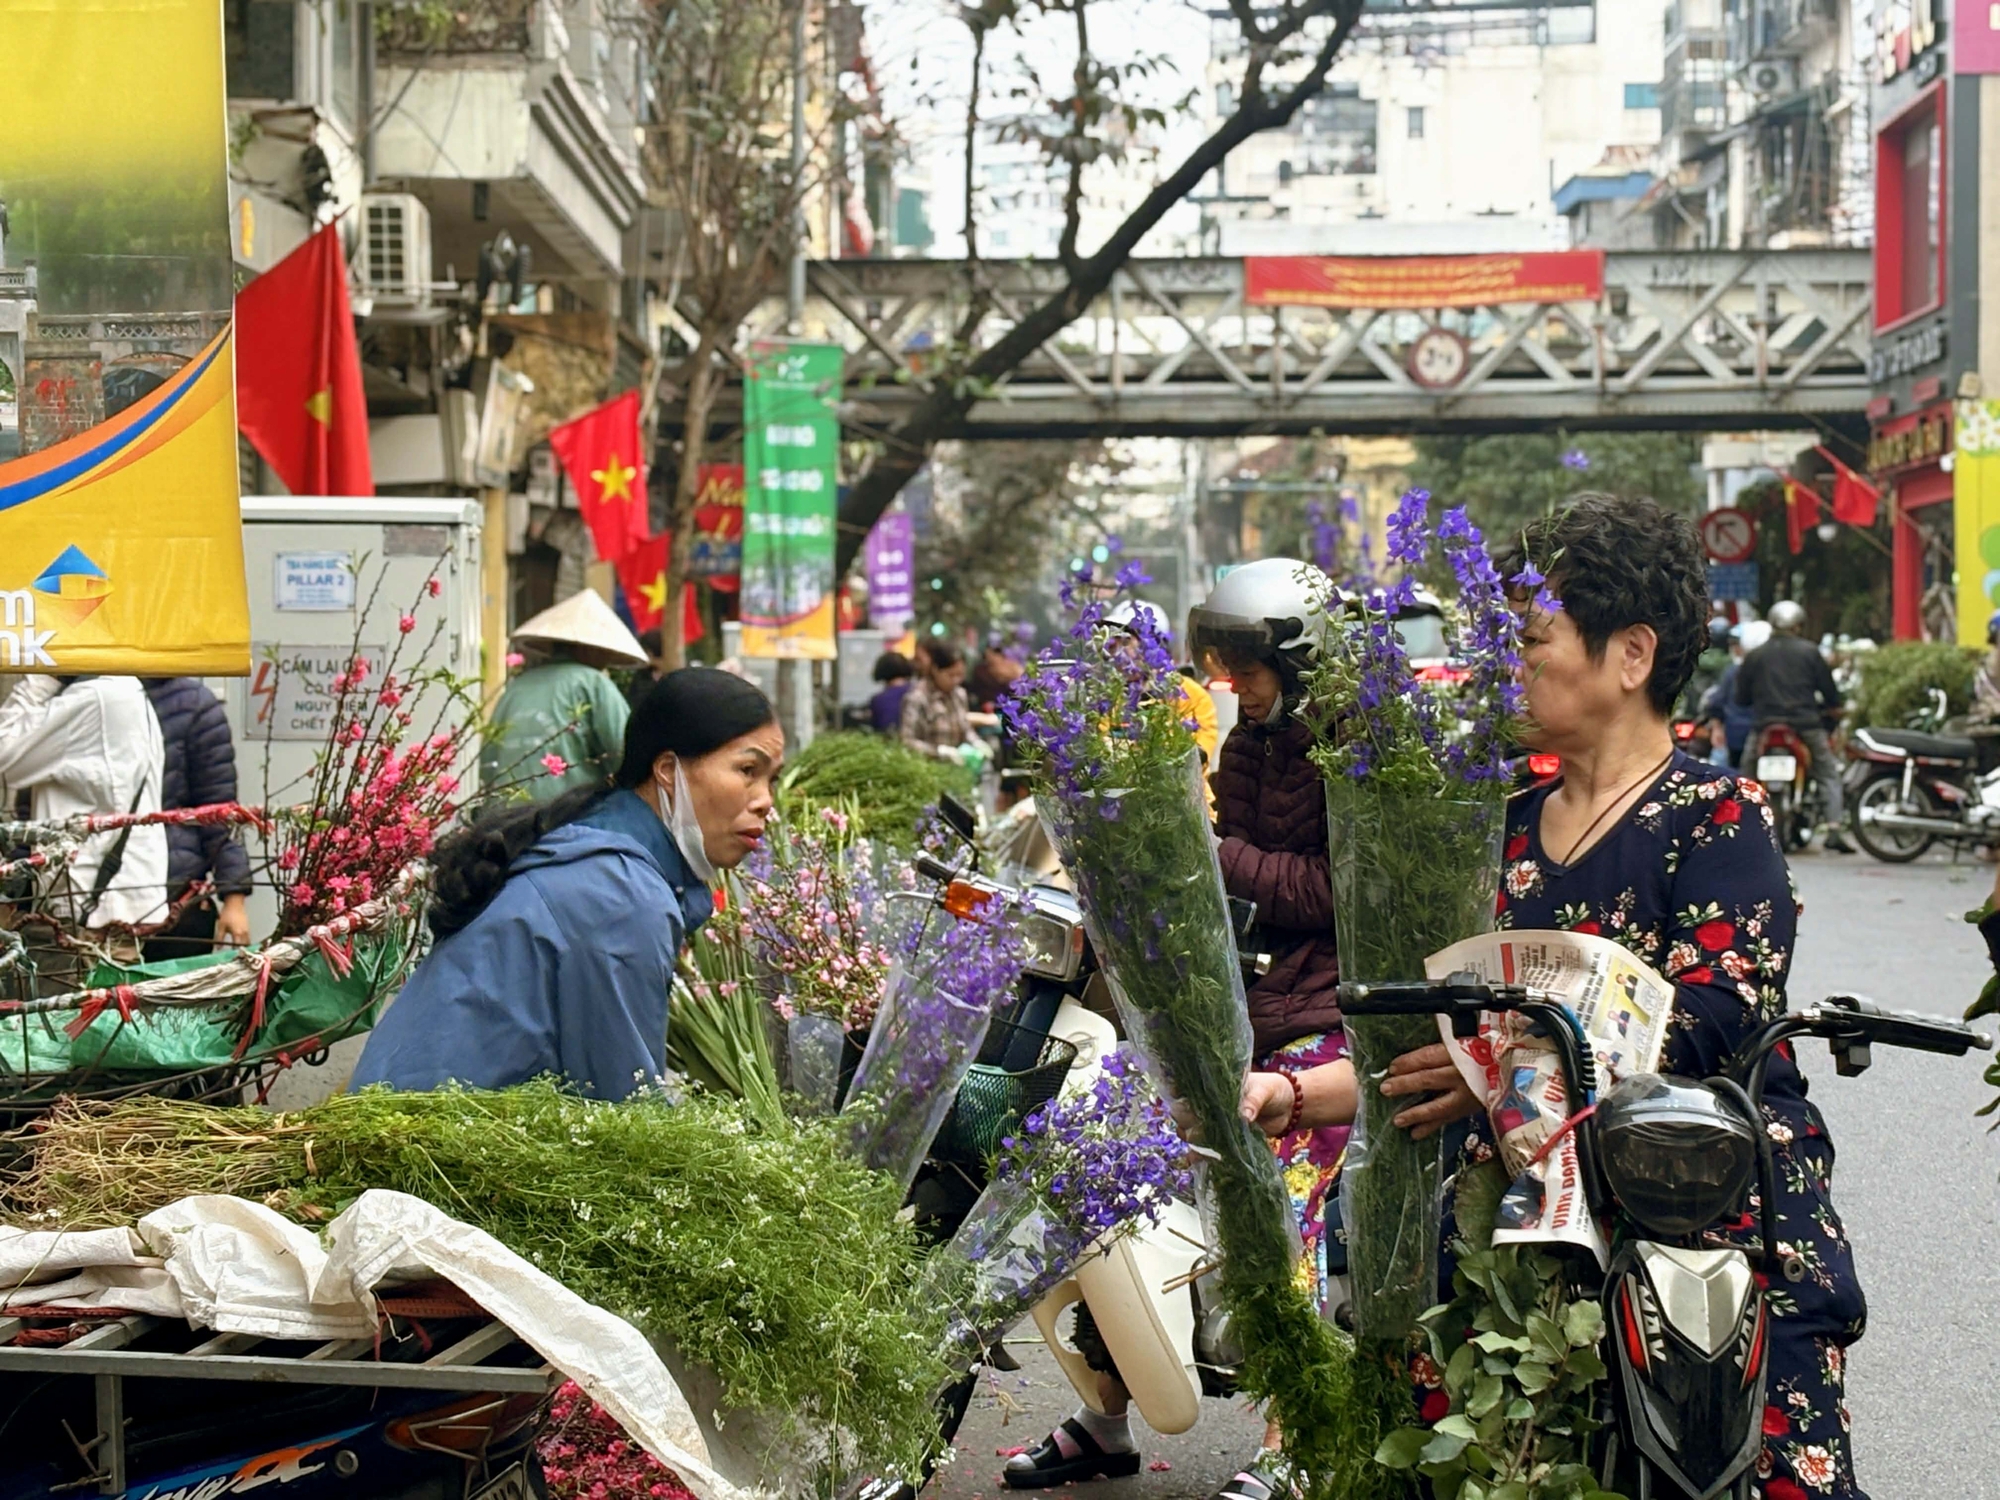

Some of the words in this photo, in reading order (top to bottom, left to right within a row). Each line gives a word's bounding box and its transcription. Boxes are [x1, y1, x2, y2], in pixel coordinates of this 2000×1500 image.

[287, 574, 333, 586] PILLAR
[337, 574, 345, 586] 2
[0, 626, 58, 667] nk
[294, 701, 332, 712] NGUY
[291, 714, 326, 729] CHẾT
[1552, 1191, 1574, 1229] VINH
